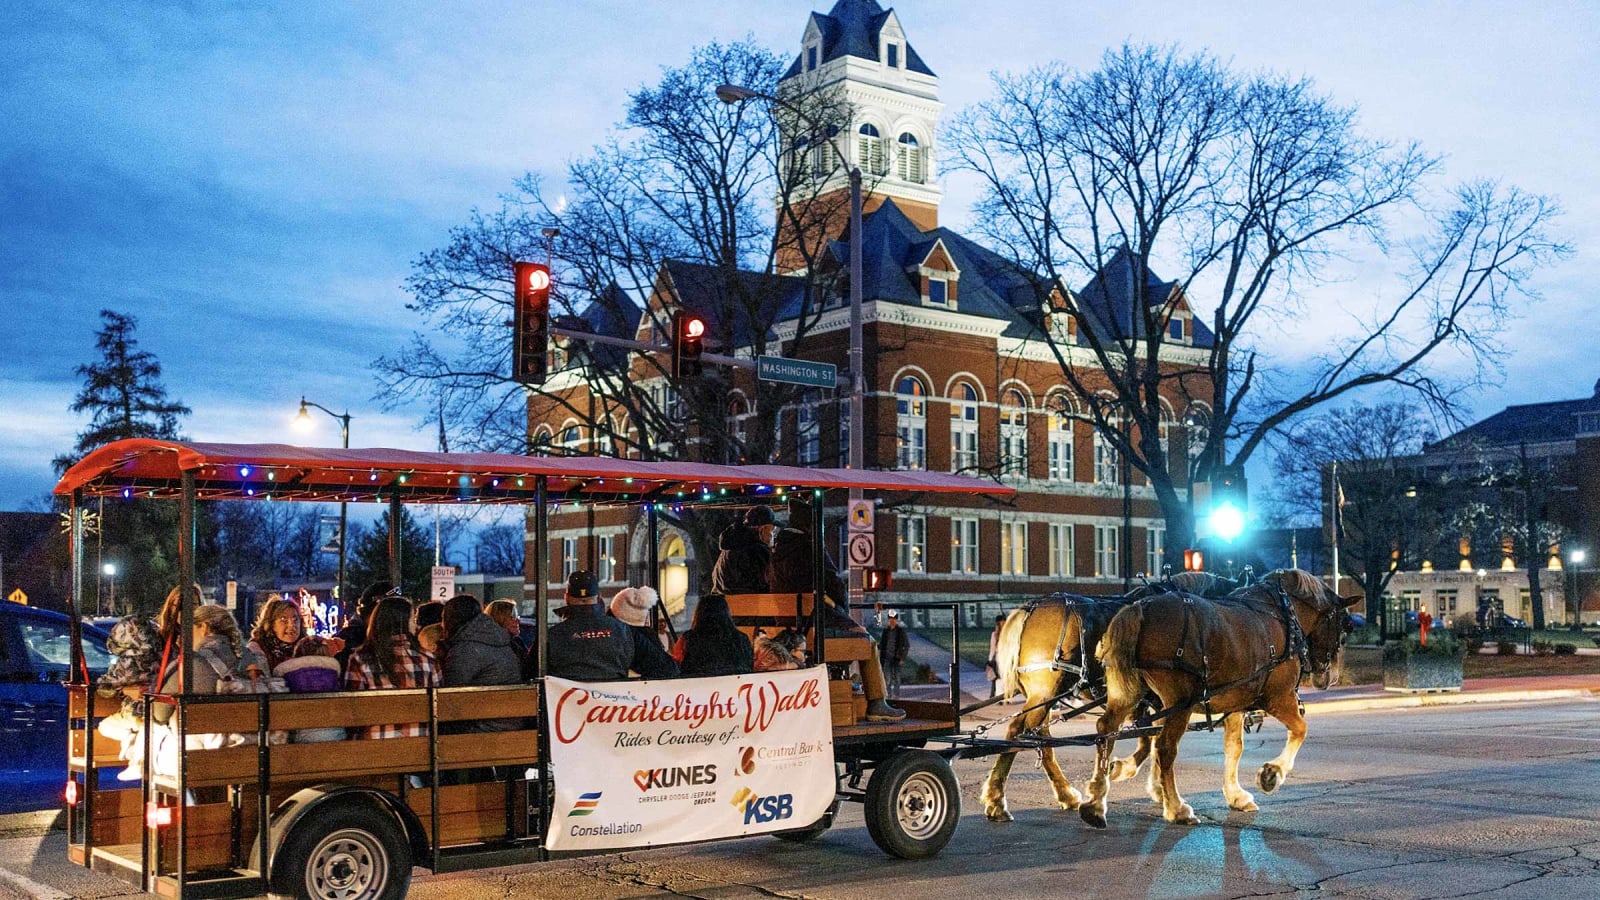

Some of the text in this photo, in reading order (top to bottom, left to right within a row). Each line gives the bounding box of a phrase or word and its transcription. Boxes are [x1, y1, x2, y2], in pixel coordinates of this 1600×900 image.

[762, 363, 817, 379] WASHINGTON
[433, 568, 454, 576] SOUTH
[439, 586, 447, 598] 2
[555, 679, 821, 744] Candlelight Walk
[614, 731, 652, 748] Rides
[657, 729, 716, 746] Courtesy
[757, 743, 798, 759] Central
[648, 764, 717, 789] KUNES
[638, 796, 668, 804] CHRYSLER
[669, 793, 690, 801] DODGE
[691, 791, 704, 799] JEEP
[743, 793, 793, 825] KSB
[570, 822, 642, 837] Constellation
